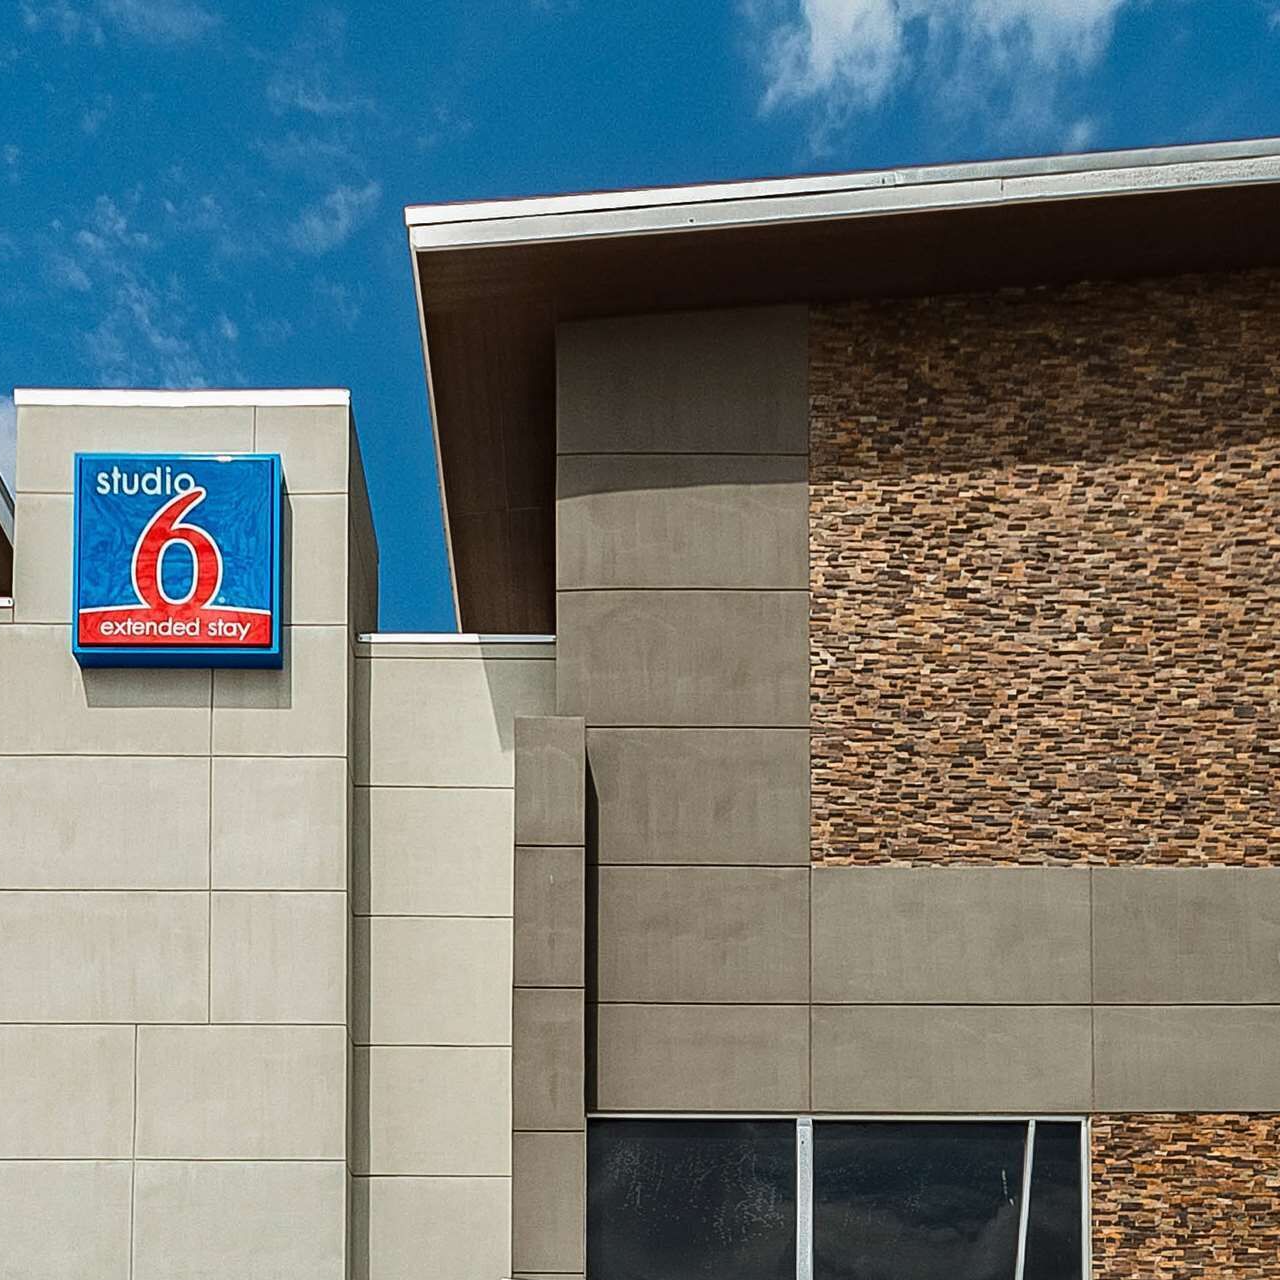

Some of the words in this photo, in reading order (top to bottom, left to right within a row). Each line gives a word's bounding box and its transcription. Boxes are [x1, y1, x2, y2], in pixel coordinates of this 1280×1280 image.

[96, 466, 195, 495] studio
[131, 486, 223, 608] 6
[99, 617, 200, 636] extended
[207, 618, 251, 641] stay
